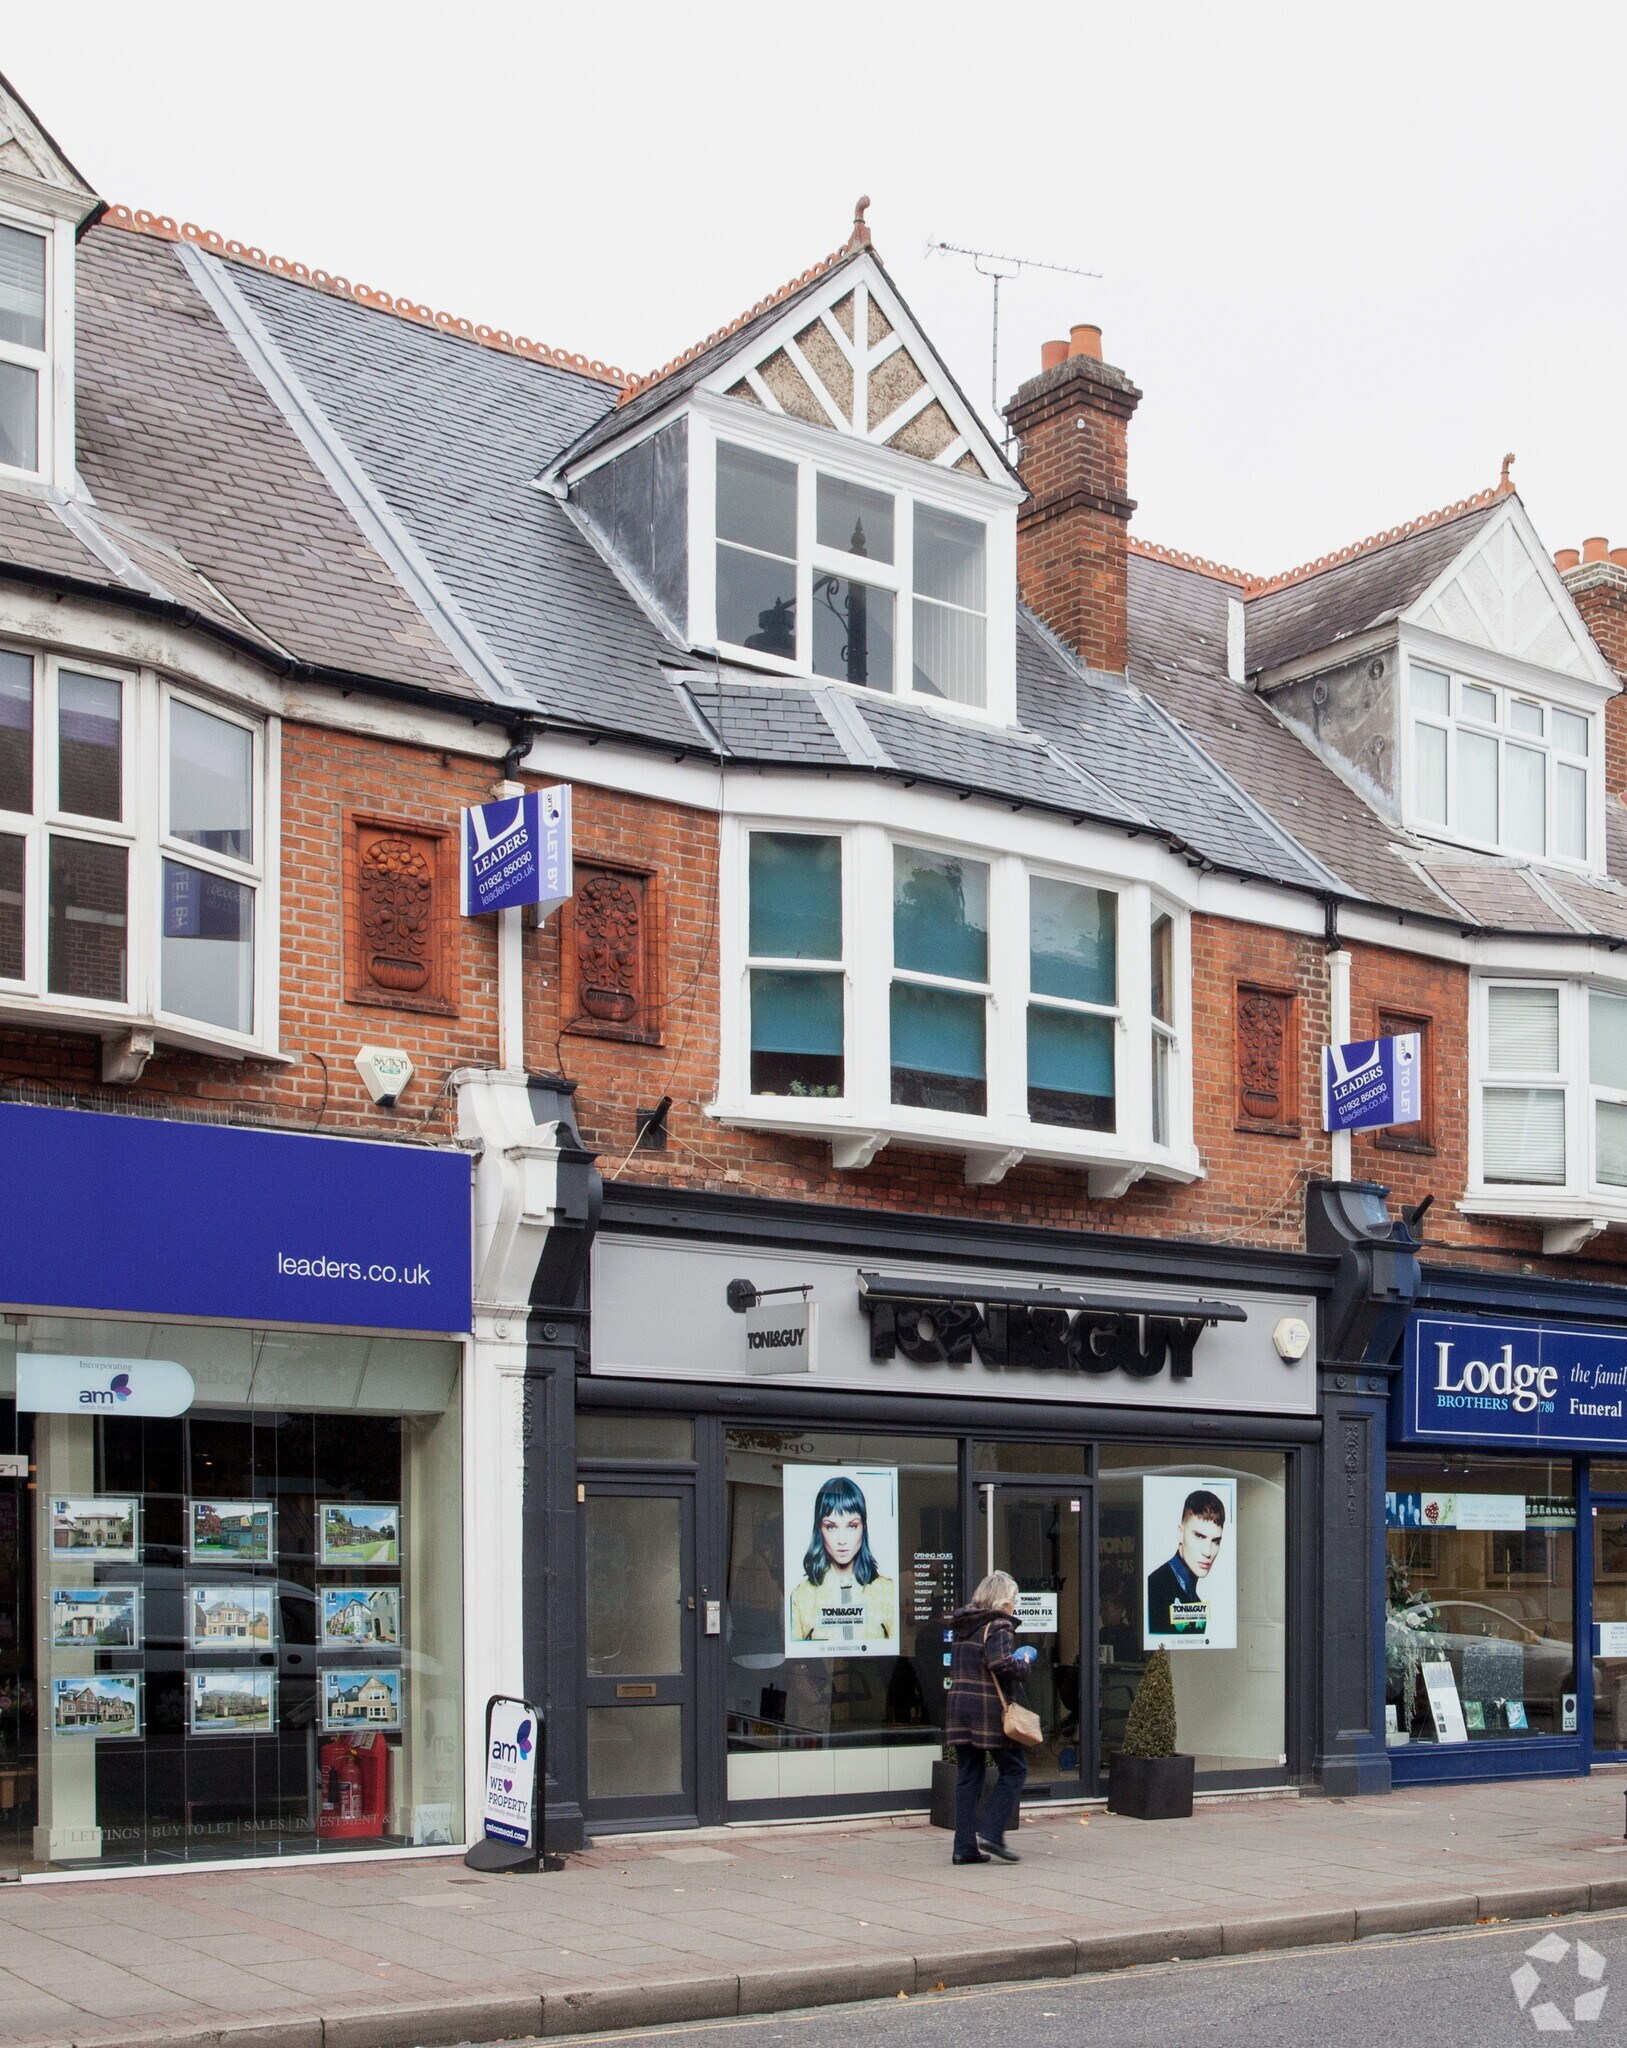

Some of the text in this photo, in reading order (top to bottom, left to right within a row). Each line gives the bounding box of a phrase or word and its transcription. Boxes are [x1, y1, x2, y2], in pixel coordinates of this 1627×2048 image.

[474, 829, 529, 876] LEADERS
[547, 829, 558, 891] LET BY
[479, 851, 532, 894] 01932 850030
[481, 863, 535, 906] leaders.co.uk
[1334, 1065, 1383, 1101] LEADERS
[1401, 1068, 1410, 1114] TO LET
[1338, 1083, 1387, 1115] 01932 850030
[1340, 1092, 1390, 1124] leaders.co.uk
[278, 1251, 431, 1286] leaders.co.uk
[747, 1328, 805, 1349] TONI&GUY
[79, 1360, 133, 1373] Incorporating
[1433, 1341, 1627, 1413] Lodge the famil
[79, 1390, 114, 1404] am
[1437, 1395, 1508, 1411] BROTHERS
[1569, 1398, 1622, 1417] Funeral
[821, 1607, 863, 1616] TONI&GUY
[1173, 1605, 1207, 1613] TONI&GUY
[492, 1740, 517, 1764] am
[490, 1776, 503, 1791] WE
[488, 1791, 528, 1814] PROPERTY
[71, 1828, 140, 1843] LETTINGS
[152, 1825, 184, 1838] BUY
[187, 1824, 204, 1836] TO
[207, 1822, 233, 1834] LET
[244, 1819, 285, 1832] SALES
[295, 1813, 379, 1829] INVESTMENT
[382, 1813, 392, 1824] &
[486, 1823, 526, 1842] astonmead.com
